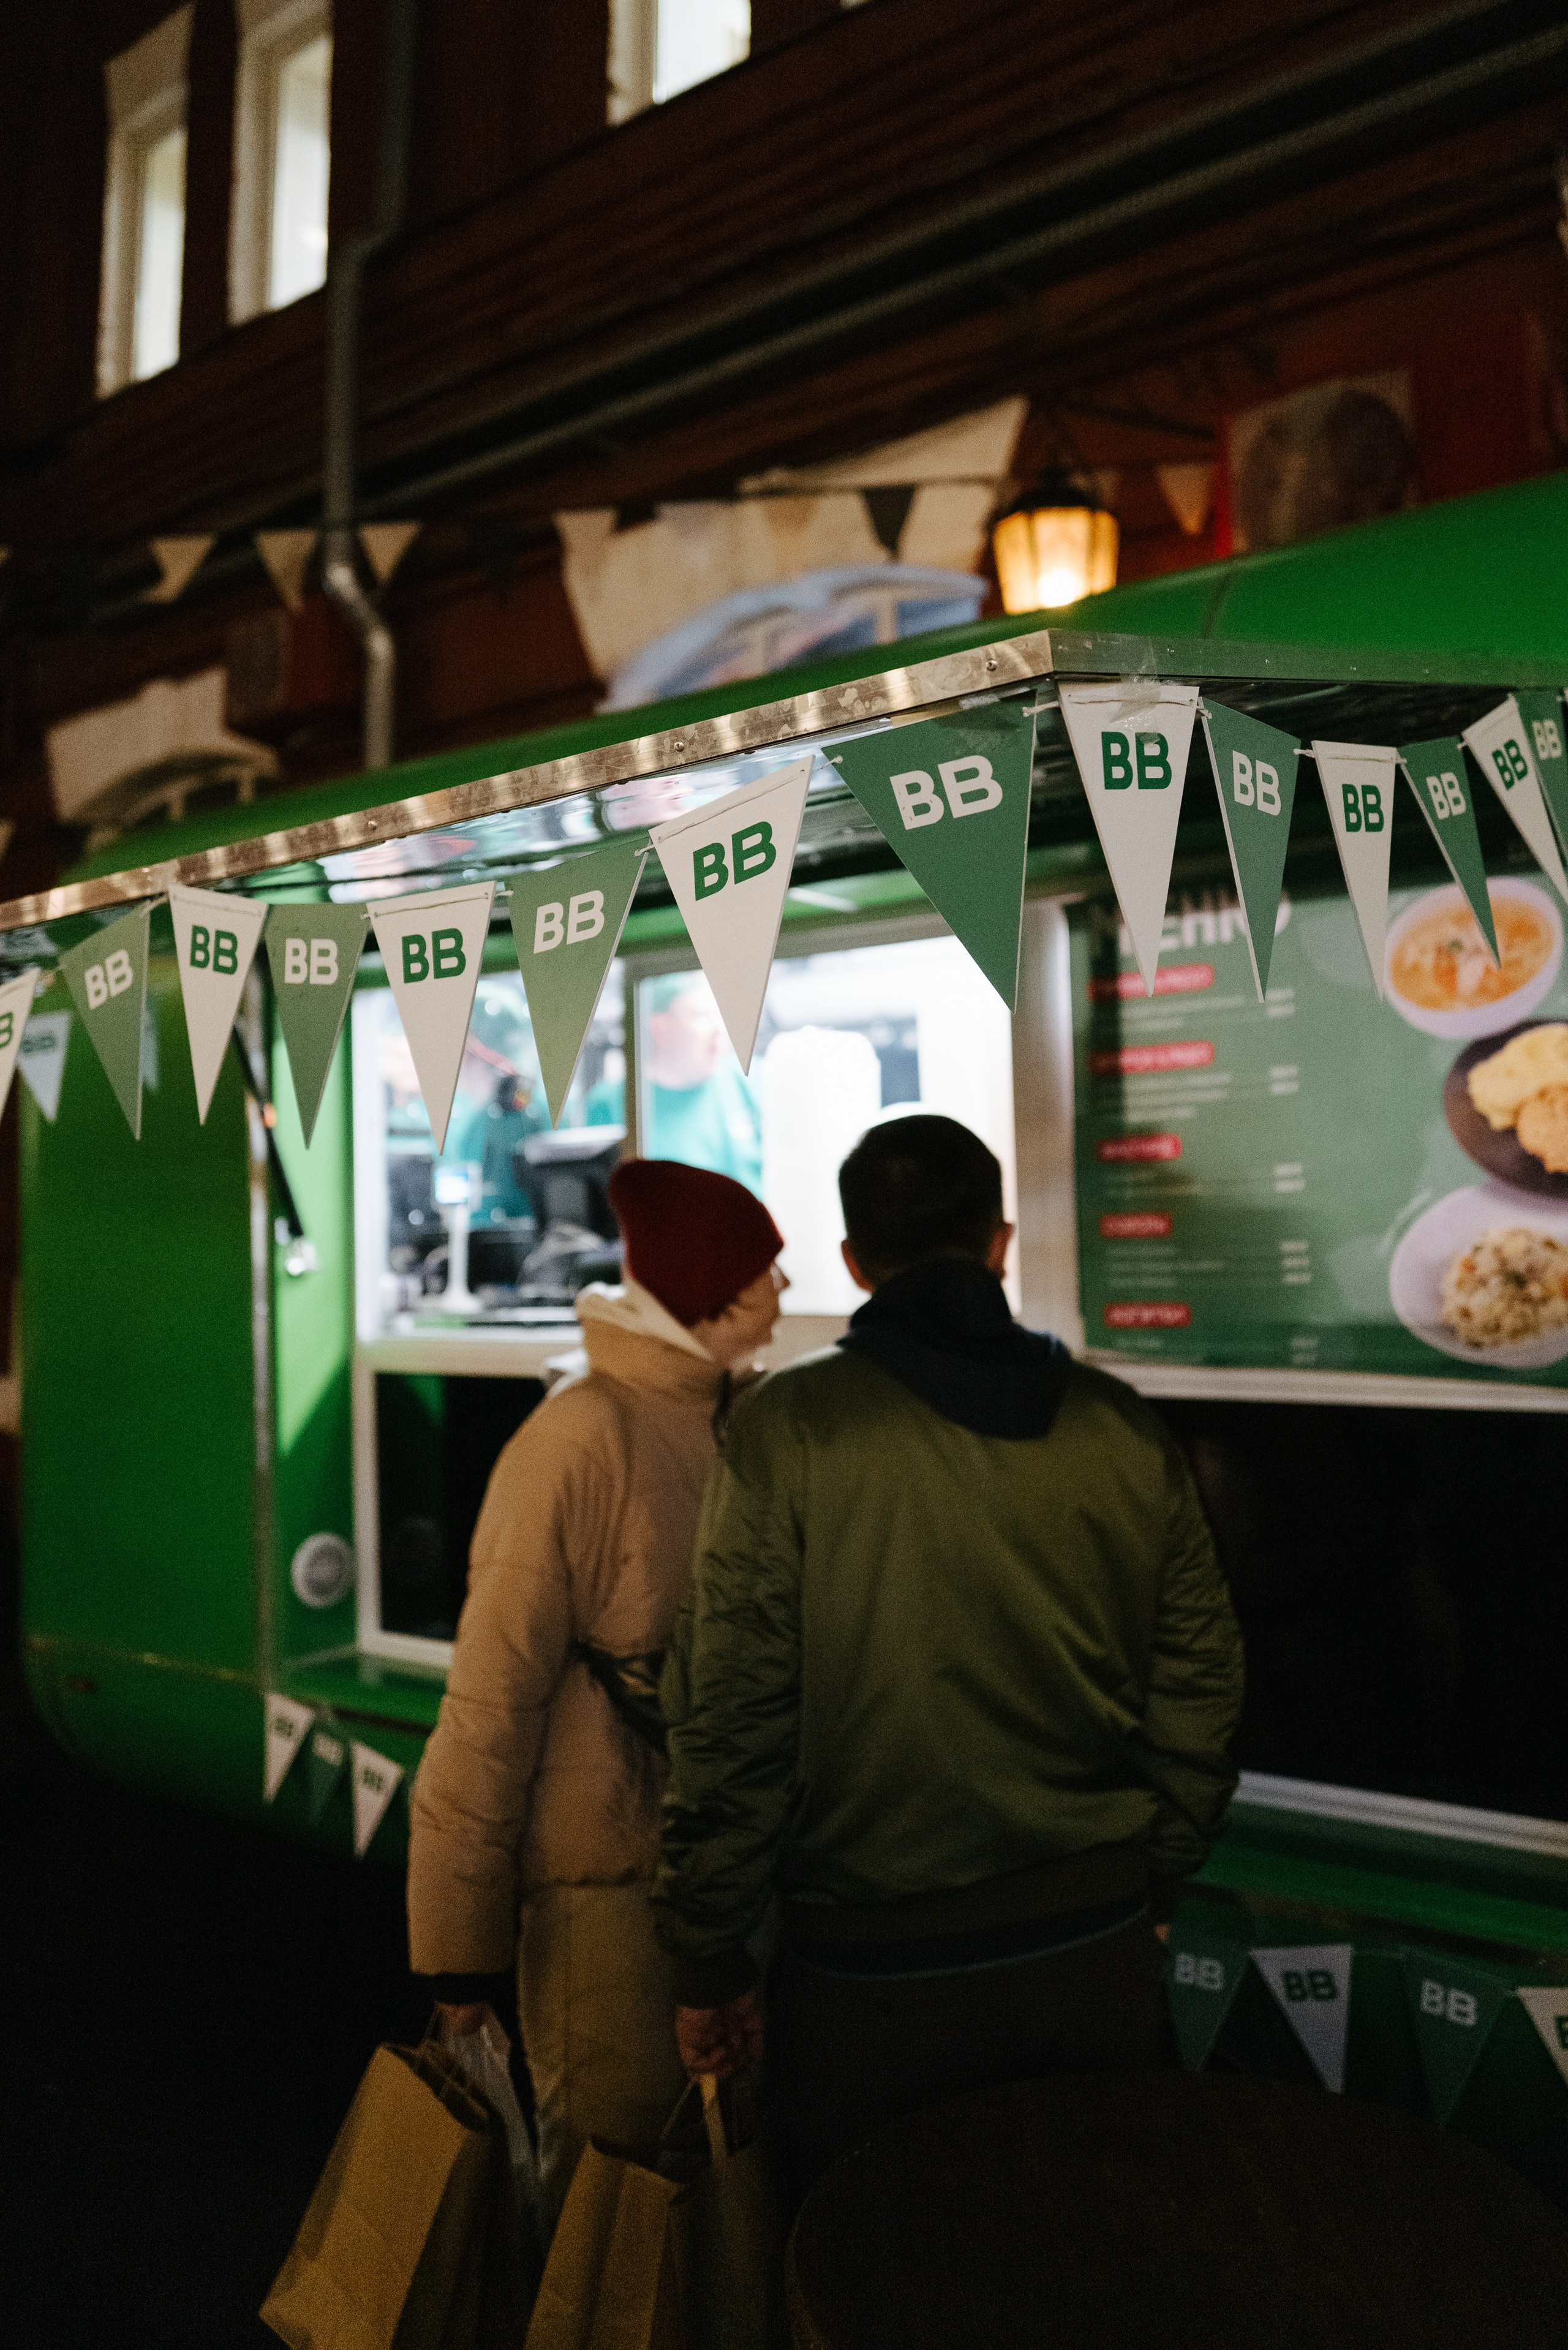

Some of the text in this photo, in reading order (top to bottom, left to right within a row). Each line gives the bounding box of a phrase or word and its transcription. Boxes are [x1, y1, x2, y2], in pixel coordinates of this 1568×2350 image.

[1101, 731, 1172, 790] BB
[1491, 739, 1528, 790] BB
[1532, 718, 1562, 761] BB
[889, 755, 1003, 830] BB
[1232, 750, 1281, 816] BB
[1341, 783, 1384, 832] BB
[1426, 772, 1466, 819] BB
[693, 821, 777, 901] BB
[533, 890, 605, 954] BB
[190, 925, 238, 975] BB
[284, 938, 339, 985] BB
[402, 928, 466, 984] BB
[84, 949, 134, 1009] BB
[1175, 1953, 1224, 1990] BB
[1281, 1969, 1340, 2004] BB
[1422, 1981, 1477, 2026] BB
